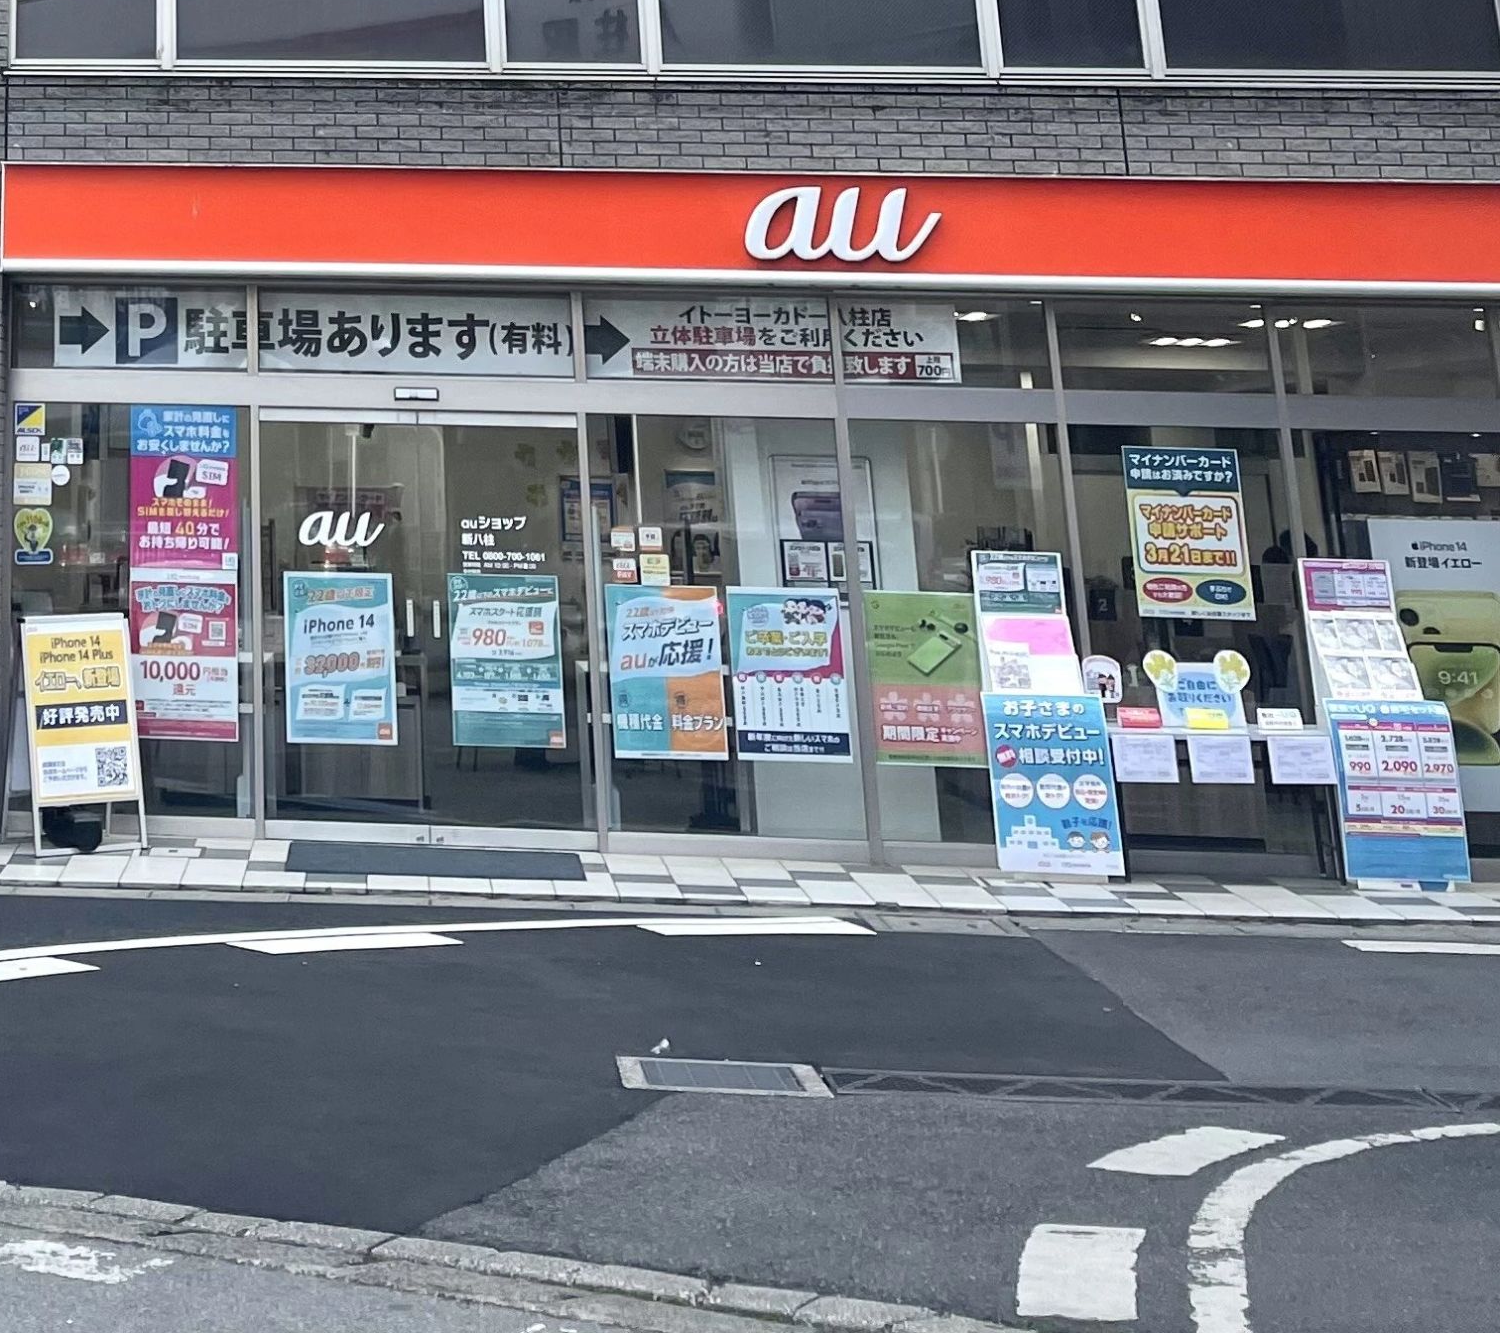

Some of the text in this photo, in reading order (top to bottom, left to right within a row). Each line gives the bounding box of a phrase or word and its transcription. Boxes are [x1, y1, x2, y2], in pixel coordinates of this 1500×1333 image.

[745, 185, 942, 262] au
[636, 352, 911, 374] 端末購入の方は当店で負致します
[1129, 454, 1232, 468] マイナンバーカード
[1139, 504, 1232, 522] マイナンバーカード
[299, 511, 385, 547] au
[461, 516, 527, 530] auショップ
[462, 551, 481, 560] TEL
[1419, 541, 1451, 553] iPhone
[1405, 557, 1483, 569] 新登場イエロー
[304, 614, 375, 634] iPhone 14
[622, 617, 714, 641] スマホデビュー
[51, 636, 101, 649] iPhone 14
[473, 628, 507, 646] 980
[40, 650, 114, 663] iPhone 14 Plus
[140, 660, 200, 681] 10,000
[1438, 670, 1479, 685] 9:41
[42, 704, 120, 725] 好評発売中
[1003, 700, 1085, 716] お子さまの
[672, 714, 725, 731] 料金プラン
[994, 723, 1100, 740] スマホデビュー
[1350, 762, 1371, 771] 990
